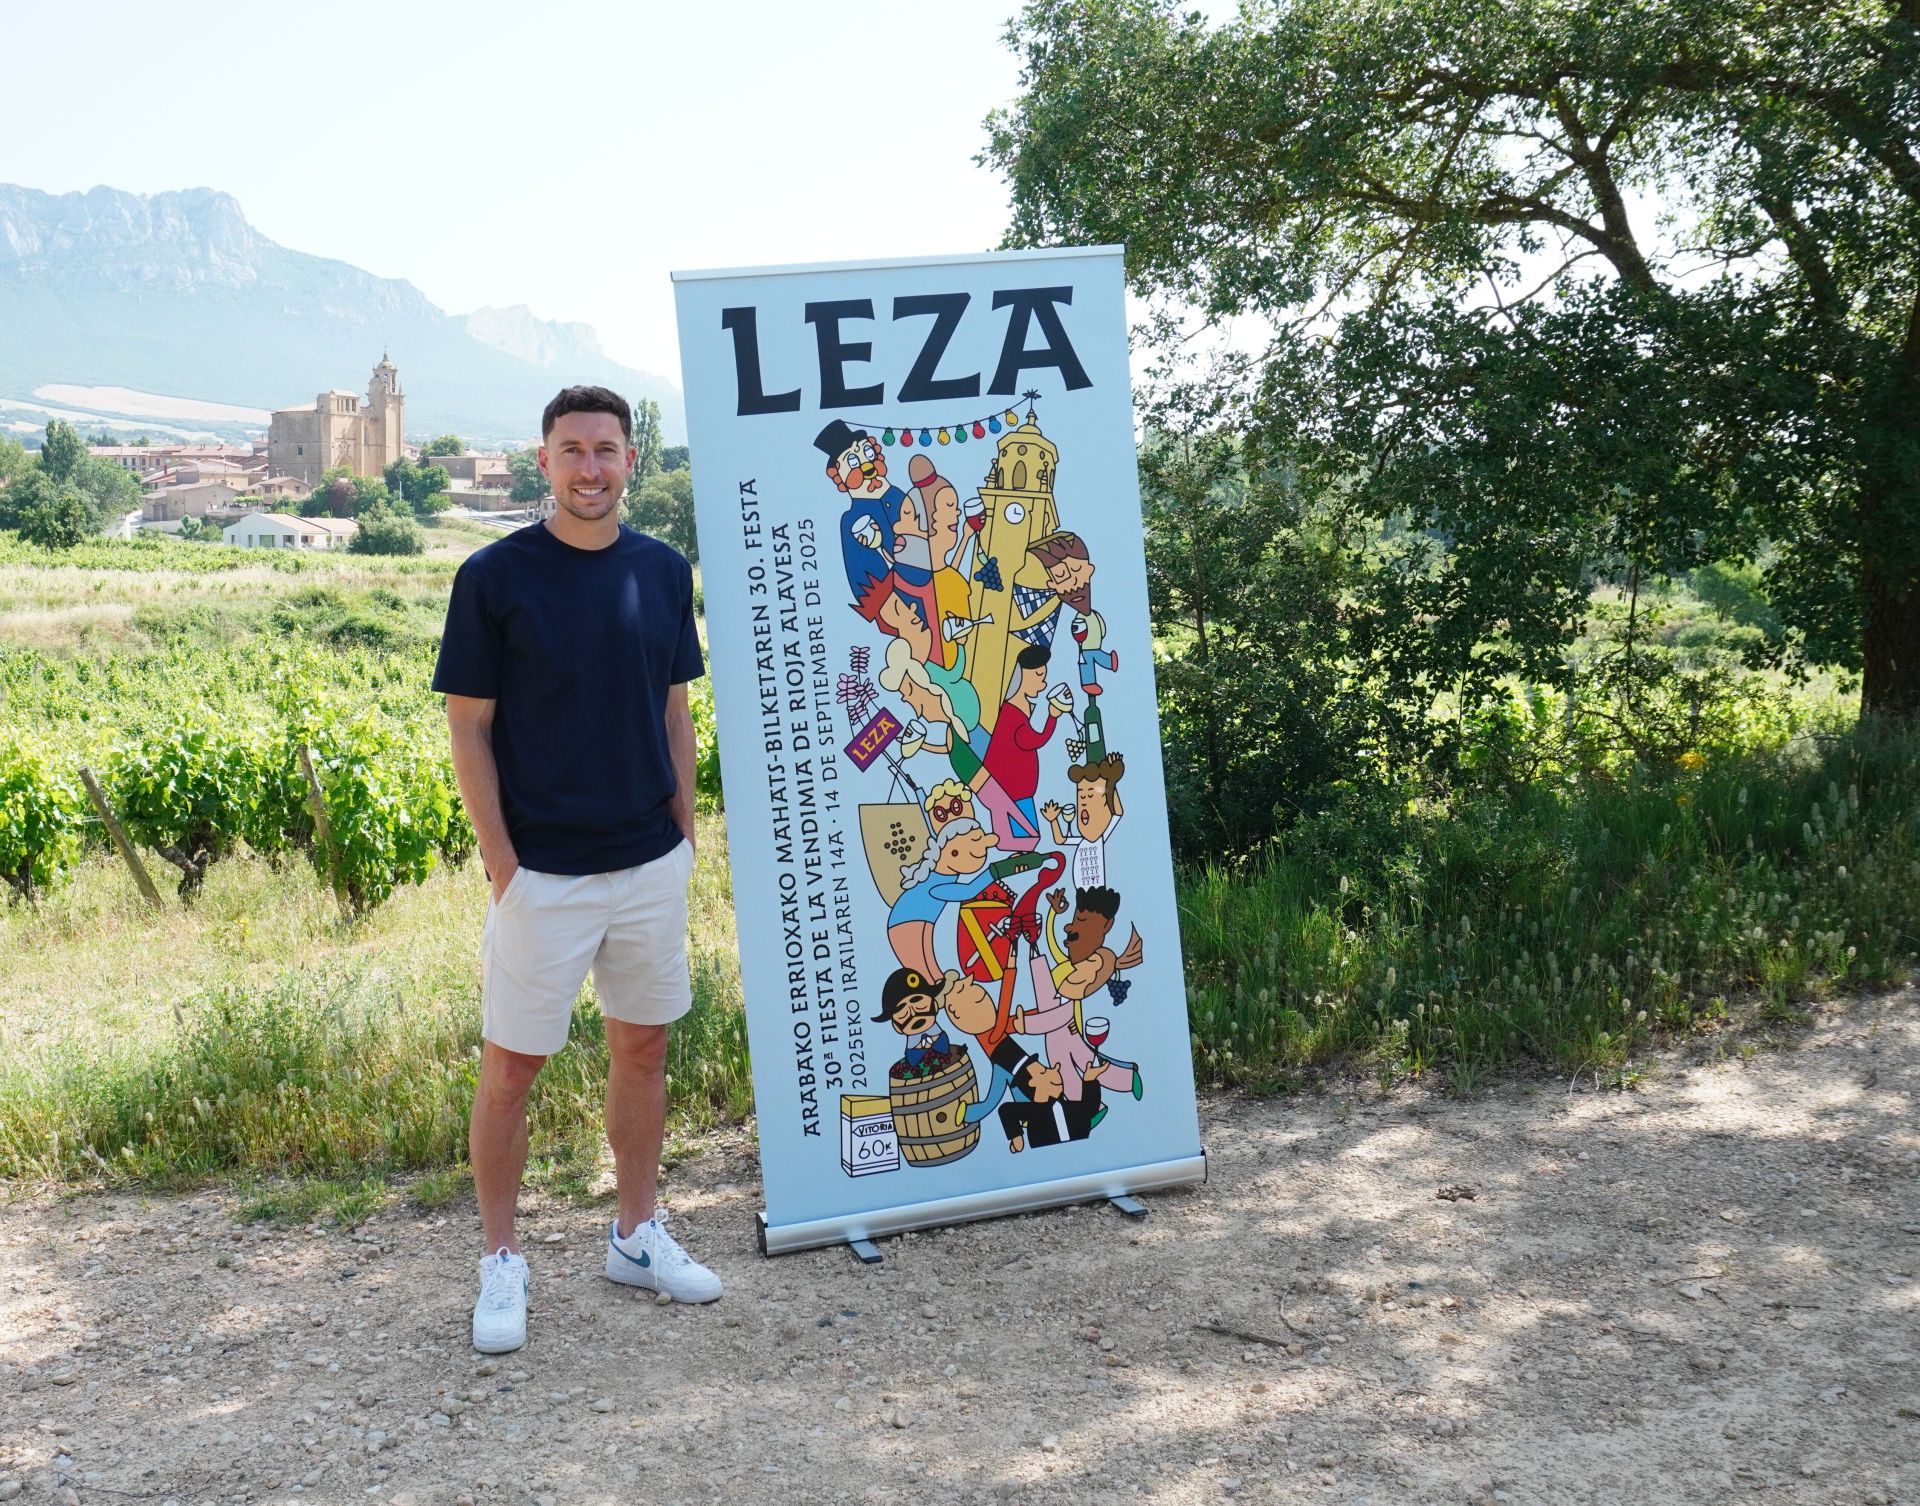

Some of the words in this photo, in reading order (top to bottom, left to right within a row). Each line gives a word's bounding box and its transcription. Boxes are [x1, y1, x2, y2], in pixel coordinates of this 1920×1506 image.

[721, 286, 1094, 416] LEZA
[738, 477, 763, 550] FESTA
[797, 518, 818, 572] 2025
[747, 558, 767, 596] 30.
[771, 522, 799, 633] ALAVESA
[803, 579, 821, 608] DE
[783, 640, 807, 713] RIOJA
[807, 615, 835, 746] SEPTIEMBRE
[751, 604, 794, 864] MAHATS-BILKETAREN
[790, 720, 811, 753] DE
[820, 754, 838, 783] DE
[852, 717, 895, 761] LEZA
[794, 758, 823, 887] VENDIMIA
[823, 789, 841, 812] 14
[827, 829, 846, 870] 14A
[778, 872, 809, 1015] ERRIOXAKO
[807, 891, 827, 923] LA
[832, 876, 858, 993] IRAILAREN
[811, 929, 831, 961] DE
[815, 966, 839, 1045] FIESTA
[793, 1021, 821, 1137] ARABAKO
[845, 999, 868, 1090] 2025EKO
[858, 1123, 893, 1136] VITORIA
